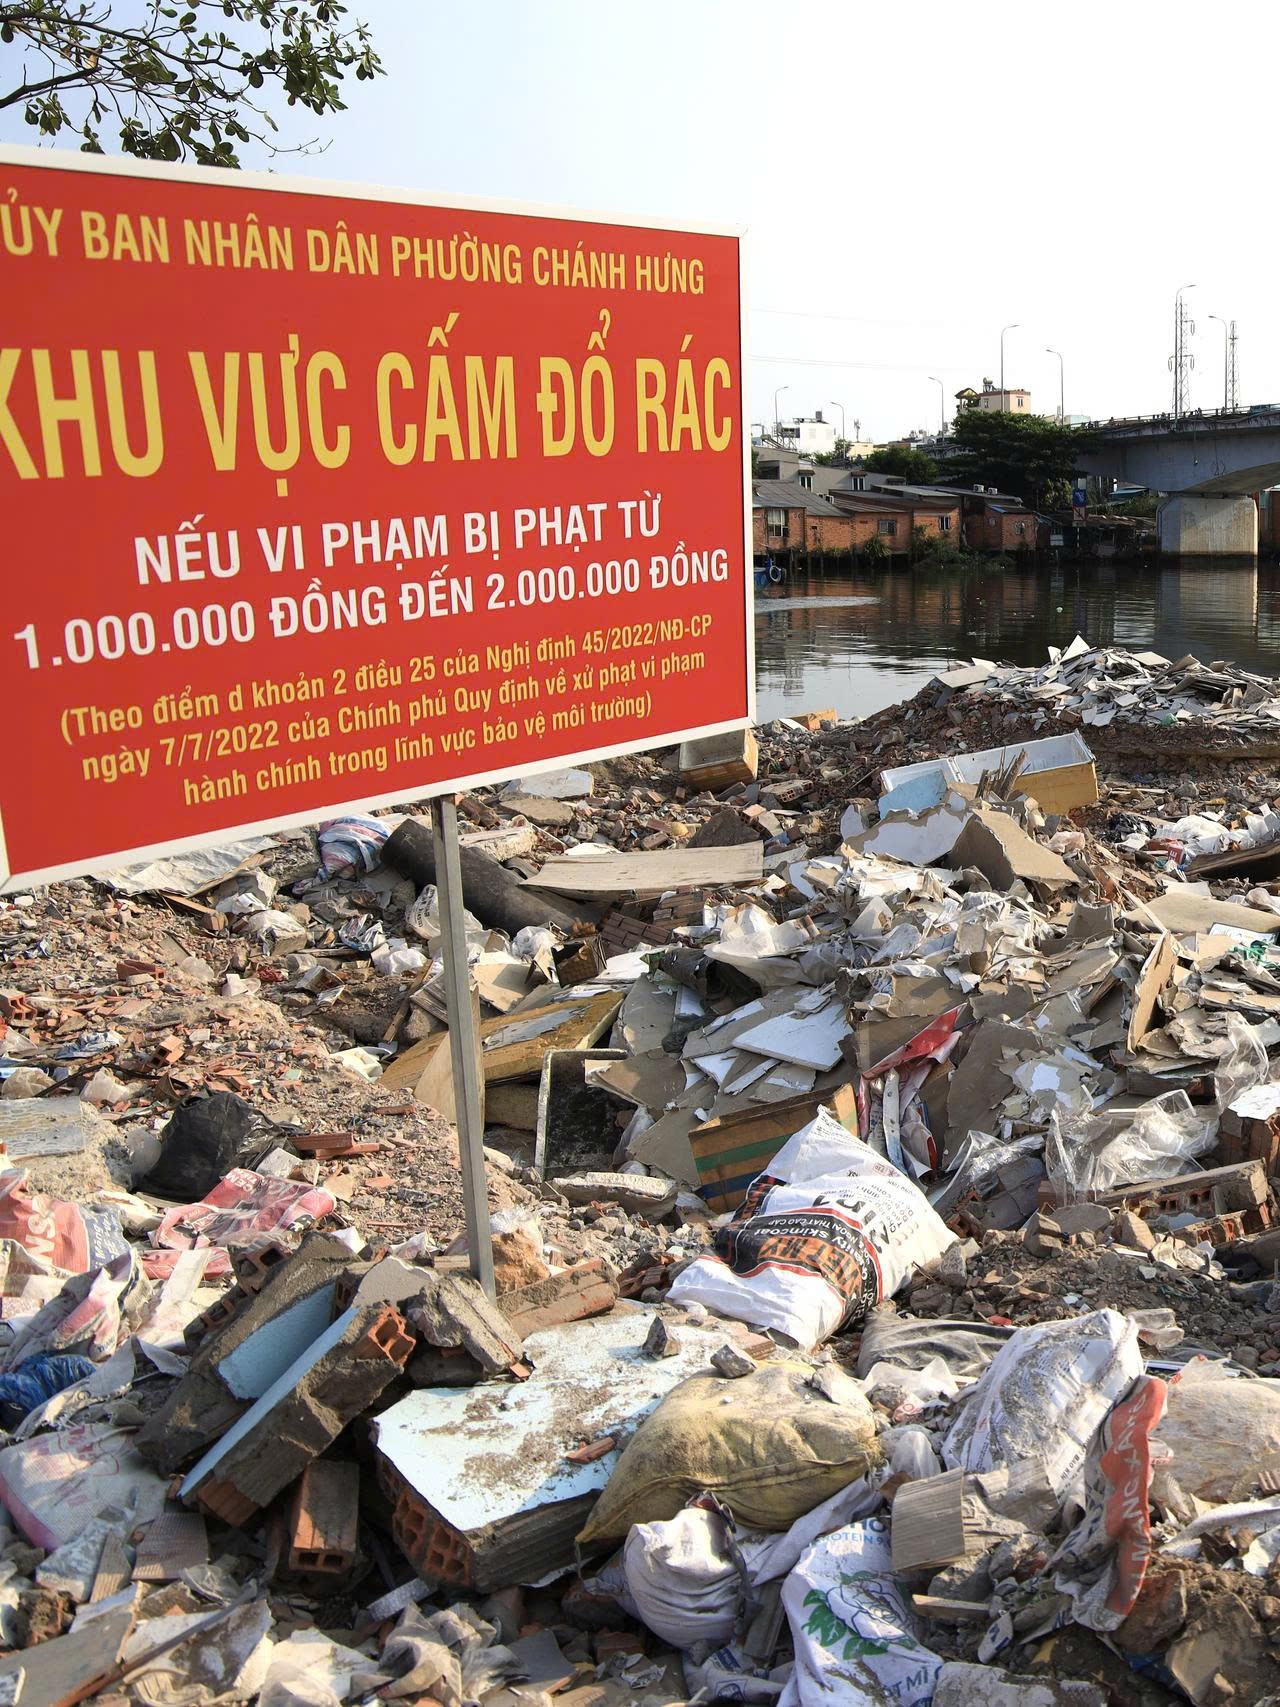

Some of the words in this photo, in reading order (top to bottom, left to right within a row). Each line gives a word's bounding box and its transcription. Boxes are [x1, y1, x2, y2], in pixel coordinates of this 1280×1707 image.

[0, 188, 62, 256] ỦY
[81, 211, 169, 263] BAN
[184, 213, 293, 270] NHÂN
[307, 221, 379, 275] DÂN
[392, 231, 522, 284] PHƯỜNG
[533, 241, 625, 289] CHÁNH
[636, 252, 704, 294] HƯNG
[188, 334, 350, 496] VỰC
[377, 312, 517, 465] CẤM
[536, 309, 614, 456] ĐỔ
[636, 334, 731, 452] RÁC
[135, 514, 240, 584] NẾU
[257, 526, 304, 572] VI
[322, 515, 448, 571] PHẠM
[464, 511, 499, 560] BỊ
[515, 503, 607, 552] PHẠT
[618, 490, 661, 538] TỪ
[14, 601, 255, 668] 1.000.000
[269, 578, 386, 637] ĐỒNG
[399, 564, 473, 621] ĐẾN
[487, 559, 639, 610] 2.000.000
[649, 541, 728, 589] ĐỒNG
[61, 706, 142, 745] (Theo
[153, 685, 219, 724] điểm
[229, 684, 243, 712] d
[252, 672, 324, 708] khoản
[333, 669, 346, 695] 2
[355, 659, 401, 691] điều
[410, 656, 435, 682] 25
[444, 649, 479, 677] của
[487, 641, 530, 672] Nghị
[537, 635, 575, 665] định
[582, 614, 711, 654] 45/2022/NĐ-CP
[83, 746, 150, 782] ngày
[160, 720, 279, 766] 7/7/2022
[288, 712, 330, 742] của
[338, 700, 400, 733] Chính
[409, 689, 446, 726] phủ
[454, 688, 491, 712] Quy
[499, 676, 539, 707] định
[546, 668, 566, 695] về
[573, 664, 593, 691] xử
[600, 660, 636, 691] phạt
[641, 656, 655, 678] vi
[662, 652, 704, 680] phạm
[184, 769, 247, 805] hành
[257, 755, 321, 790] chính
[329, 747, 387, 775] trong
[395, 733, 433, 762] lĩnh
[440, 728, 475, 755] vực
[483, 716, 517, 744] bảo
[524, 711, 545, 738] vệ
[552, 703, 584, 730] môi
[591, 691, 651, 722] trường)
